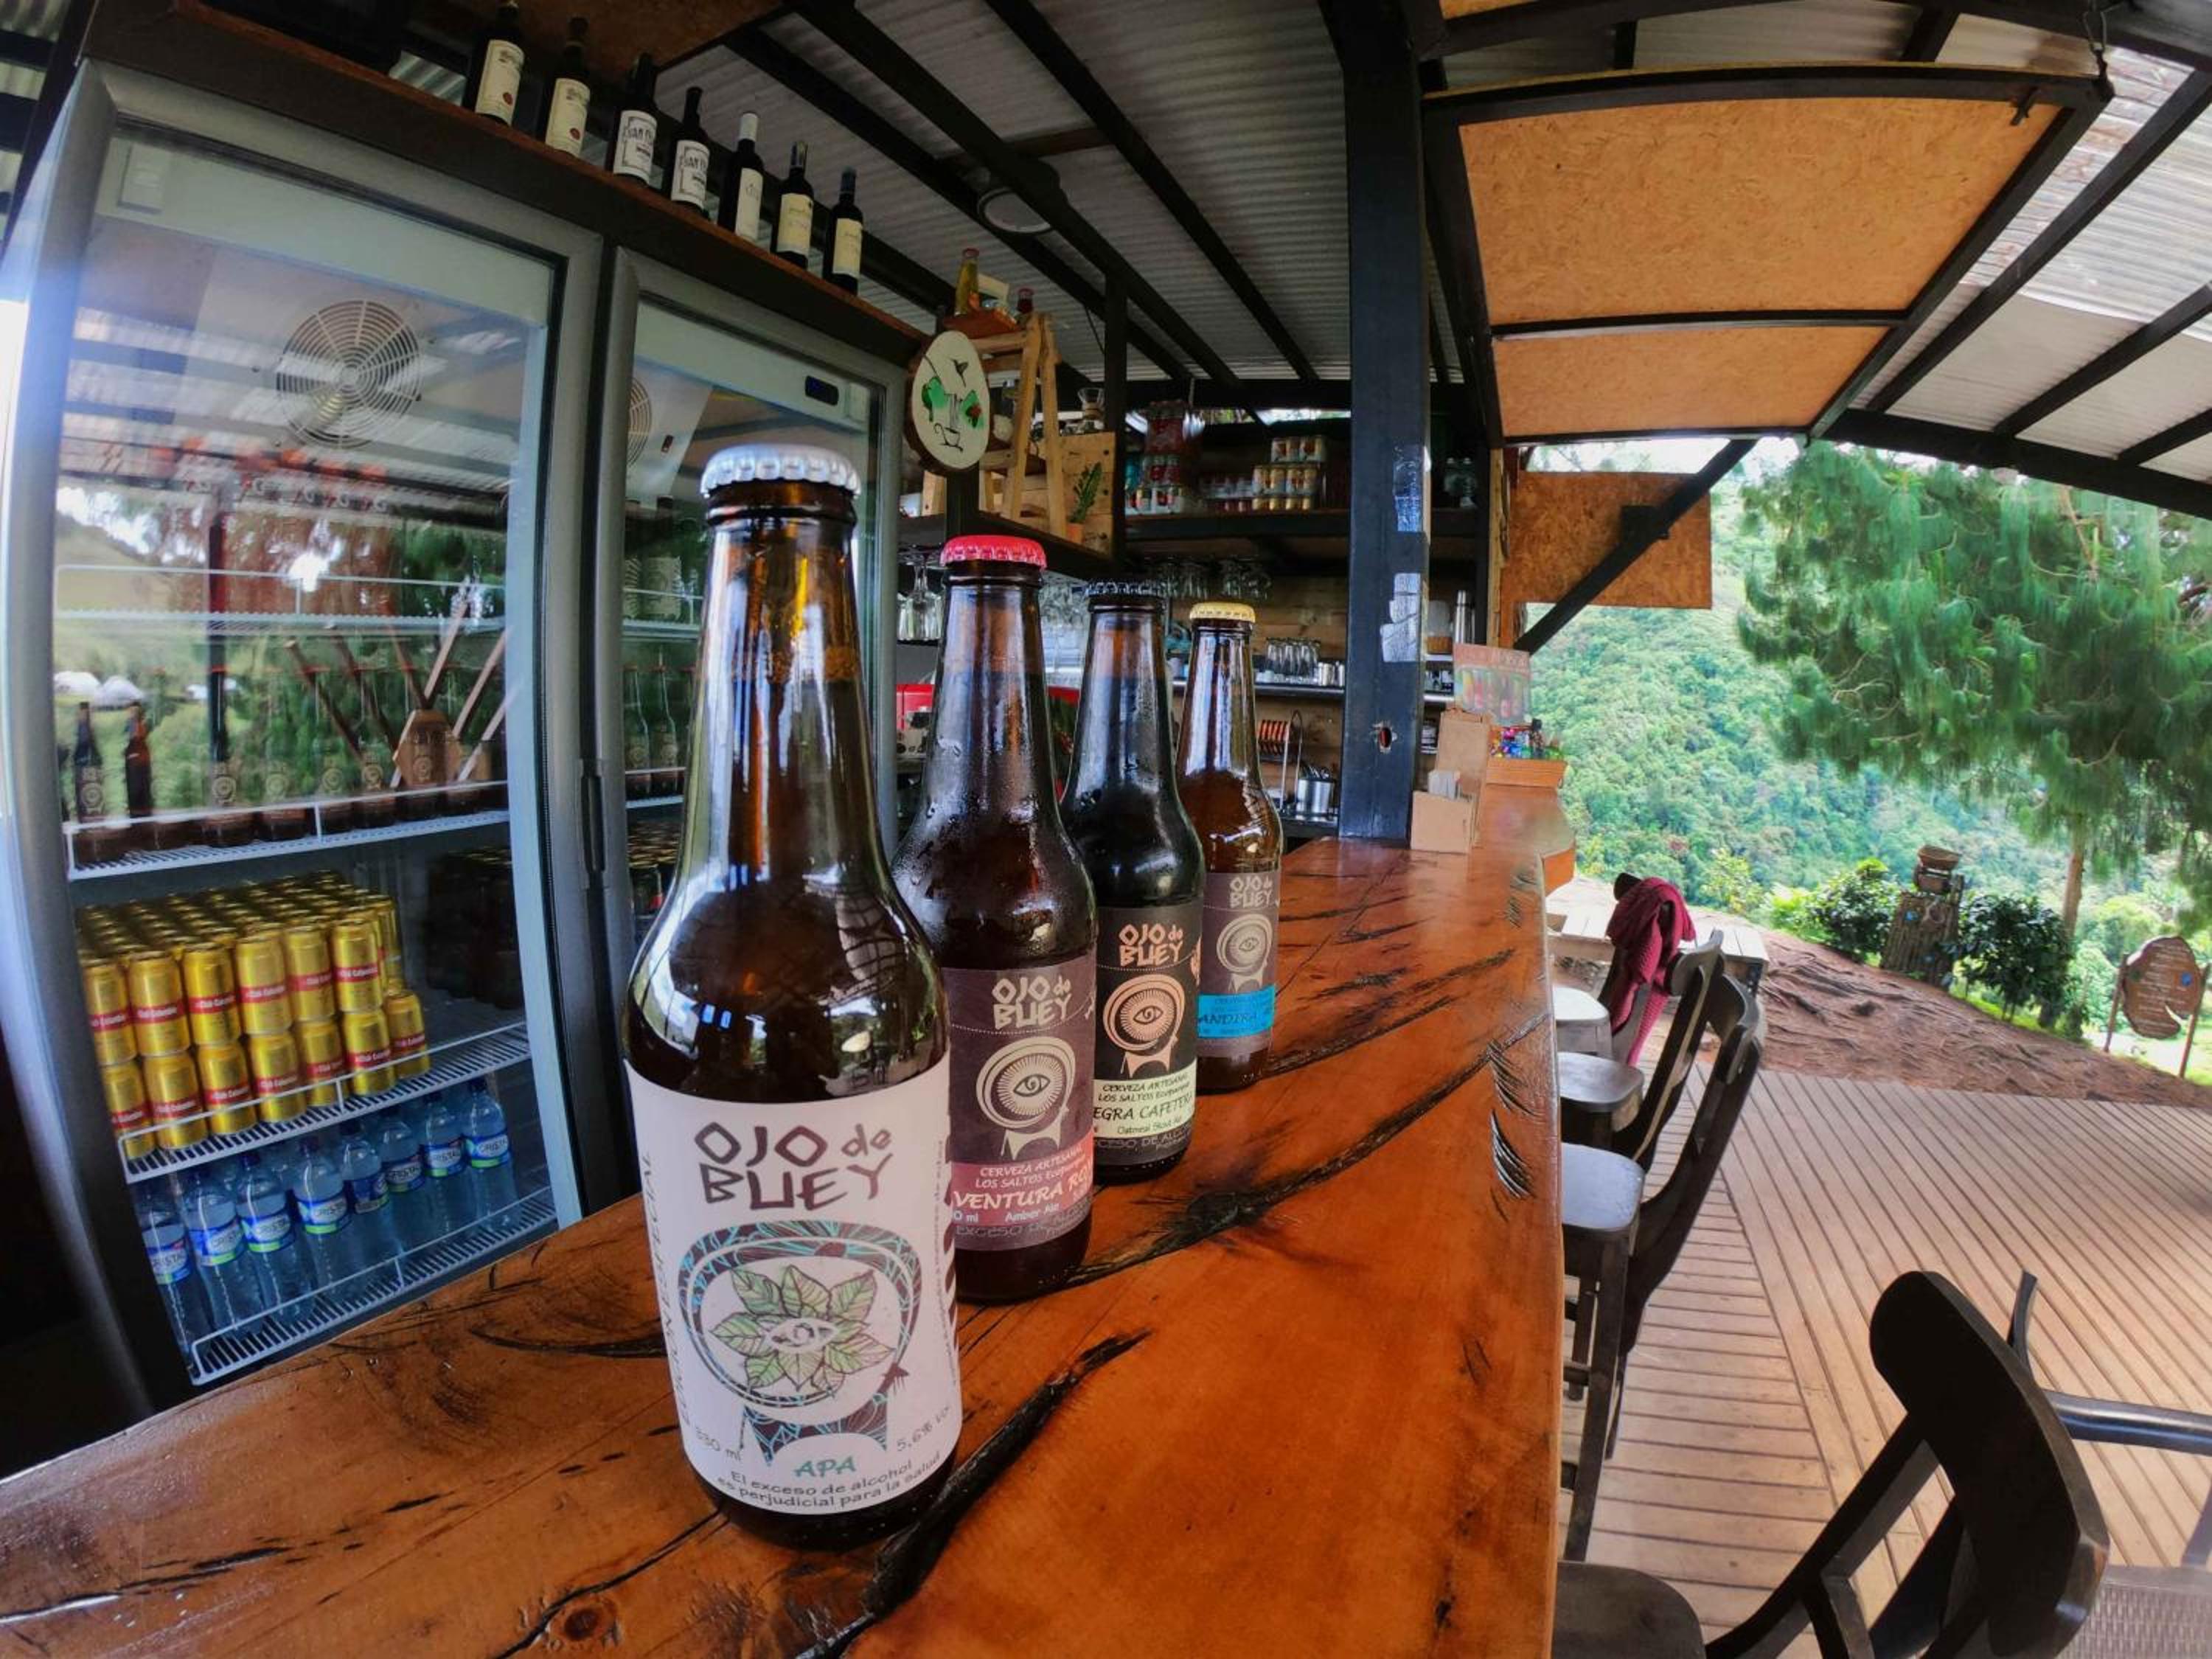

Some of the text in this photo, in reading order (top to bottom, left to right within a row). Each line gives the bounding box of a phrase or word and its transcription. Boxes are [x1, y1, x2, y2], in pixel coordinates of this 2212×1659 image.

[1229, 889, 1273, 908] BUEY
[1119, 923, 1183, 945] OJO de
[1119, 940, 1183, 967] BUEY
[992, 975, 1072, 1004] OJO de
[993, 993, 1072, 1030] BUEY
[1098, 1093, 1116, 1102] LOS
[1119, 1092, 1155, 1102] SALTOS
[1102, 1083, 1146, 1092] CERVEZA
[1093, 1107, 1134, 1120] EGRA
[695, 1121, 892, 1166] OJO de
[699, 1152, 894, 1211] BUEY
[975, 1178, 998, 1189] LOS
[1001, 1172, 1046, 1188] SALTOS
[980, 1165, 1032, 1178] CERVEZA
[953, 1181, 1063, 1210] VENTURA
[731, 1458, 912, 1496] El exceso de alcohol
[739, 1487, 835, 1508] perjudicial
[841, 1488, 882, 1508] para
[887, 1480, 900, 1492] la
[904, 1450, 941, 1484] salud
[793, 1455, 857, 1478] APA
